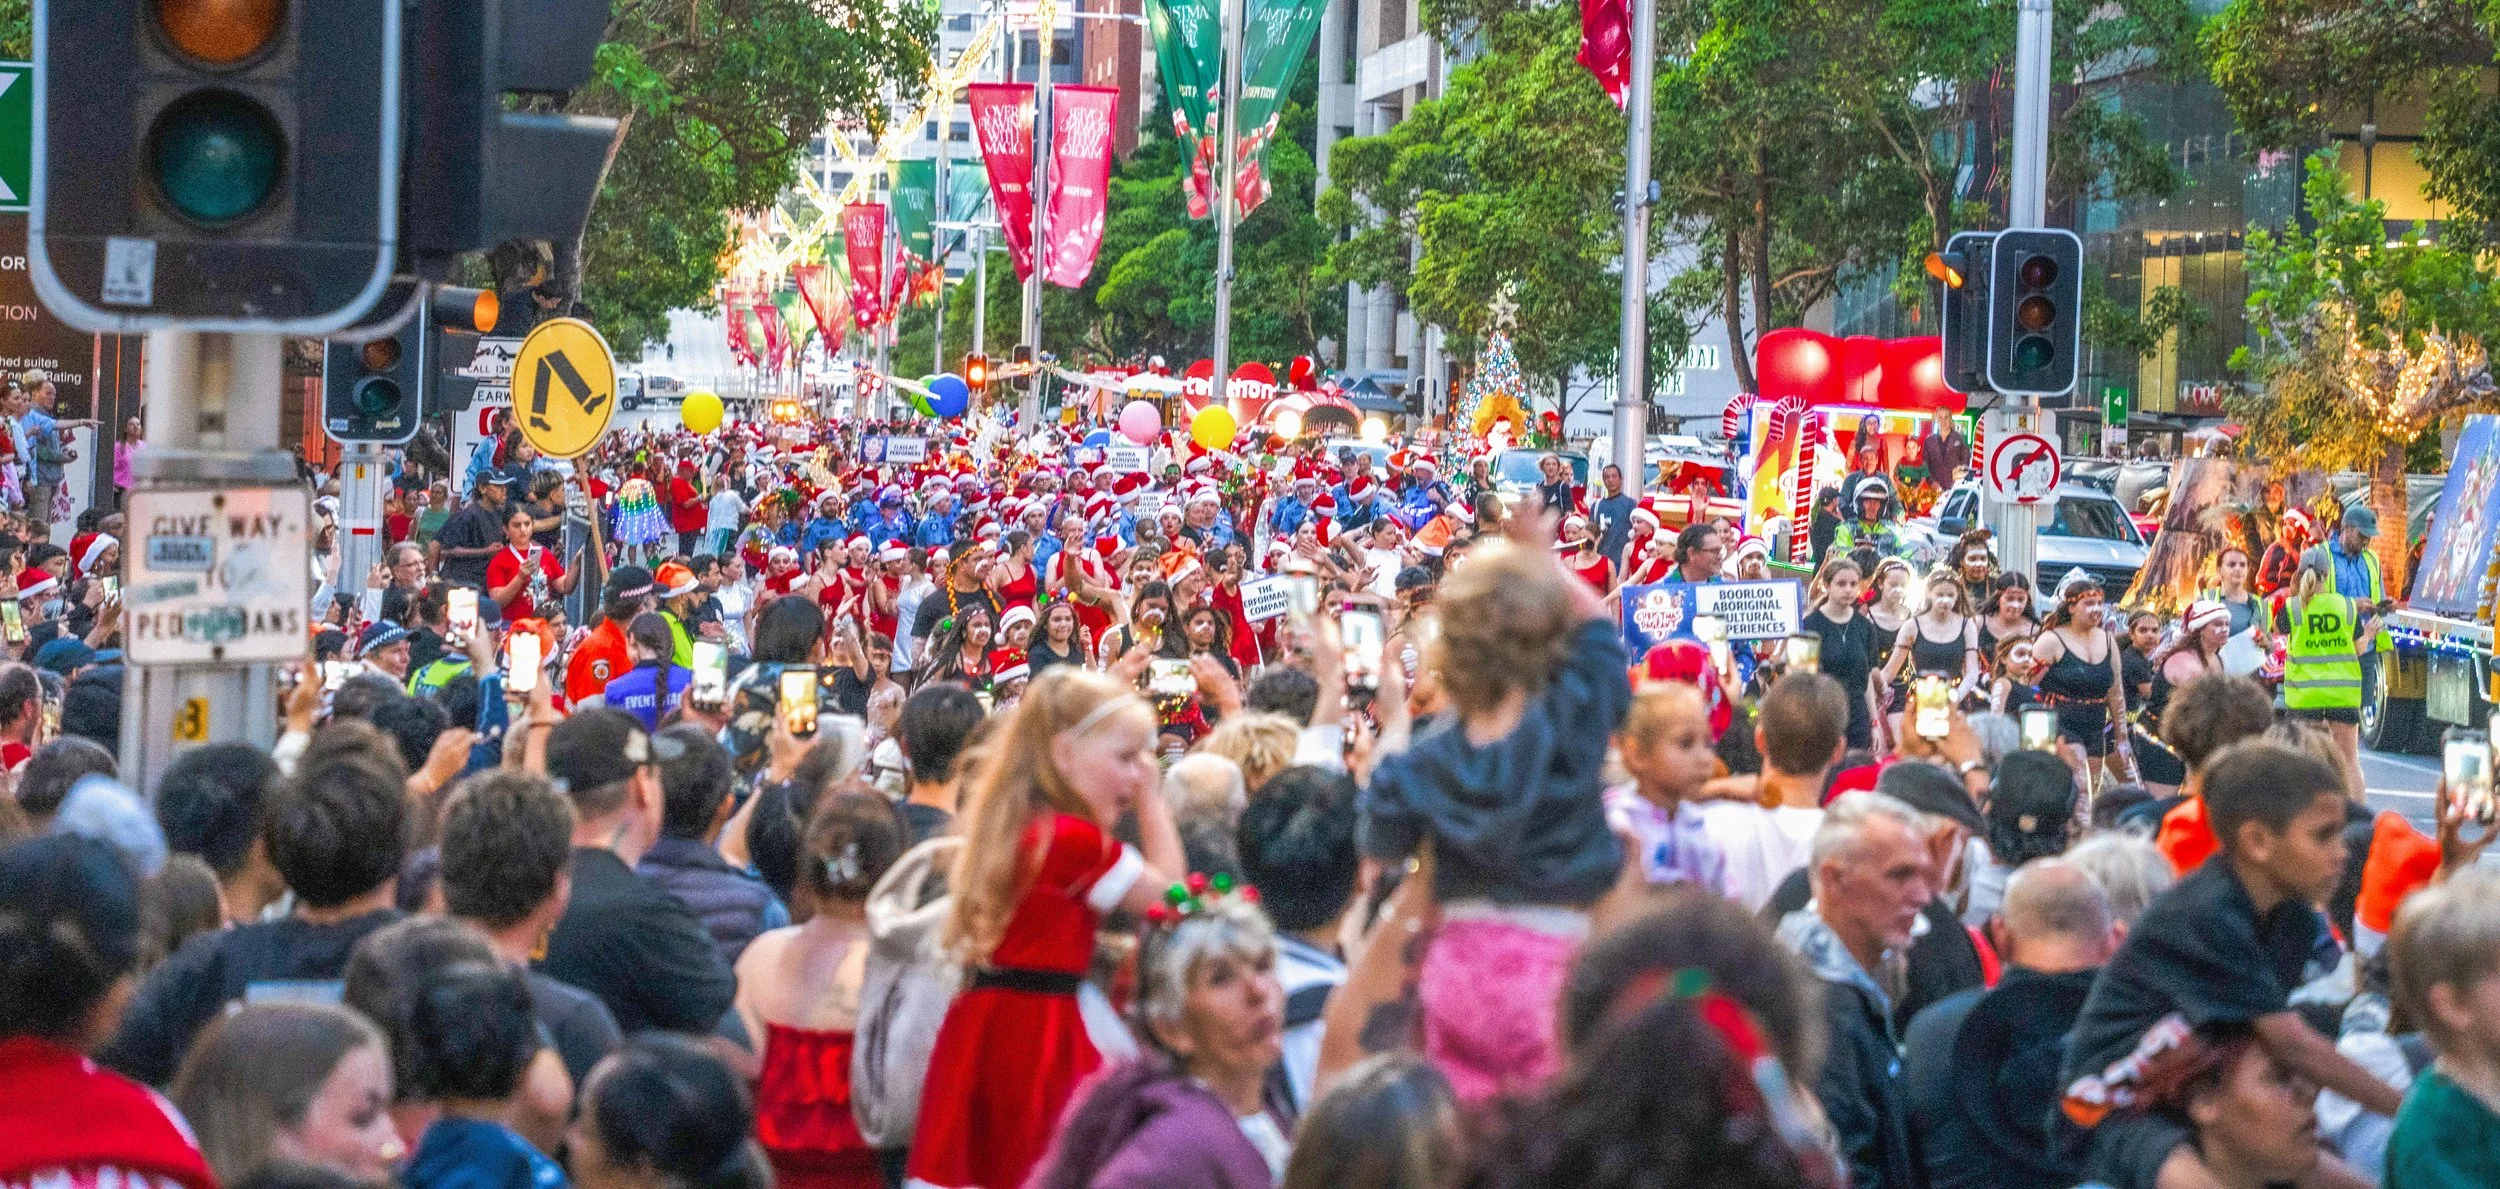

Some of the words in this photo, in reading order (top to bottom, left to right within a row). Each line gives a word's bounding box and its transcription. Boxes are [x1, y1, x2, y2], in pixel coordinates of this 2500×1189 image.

[24, 357, 58, 369] suites
[2113, 395, 2122, 407] 4
[228, 514, 283, 537] WAY
[1257, 584, 1273, 595] THE
[1719, 588, 1773, 600] BOORLOO
[1712, 599, 1782, 613] ABORIGINAL
[1726, 611, 1776, 623] ULTURAL
[1726, 622, 1786, 635] PERIENCES
[2308, 613, 2341, 635] RD
[2305, 636, 2348, 649] events
